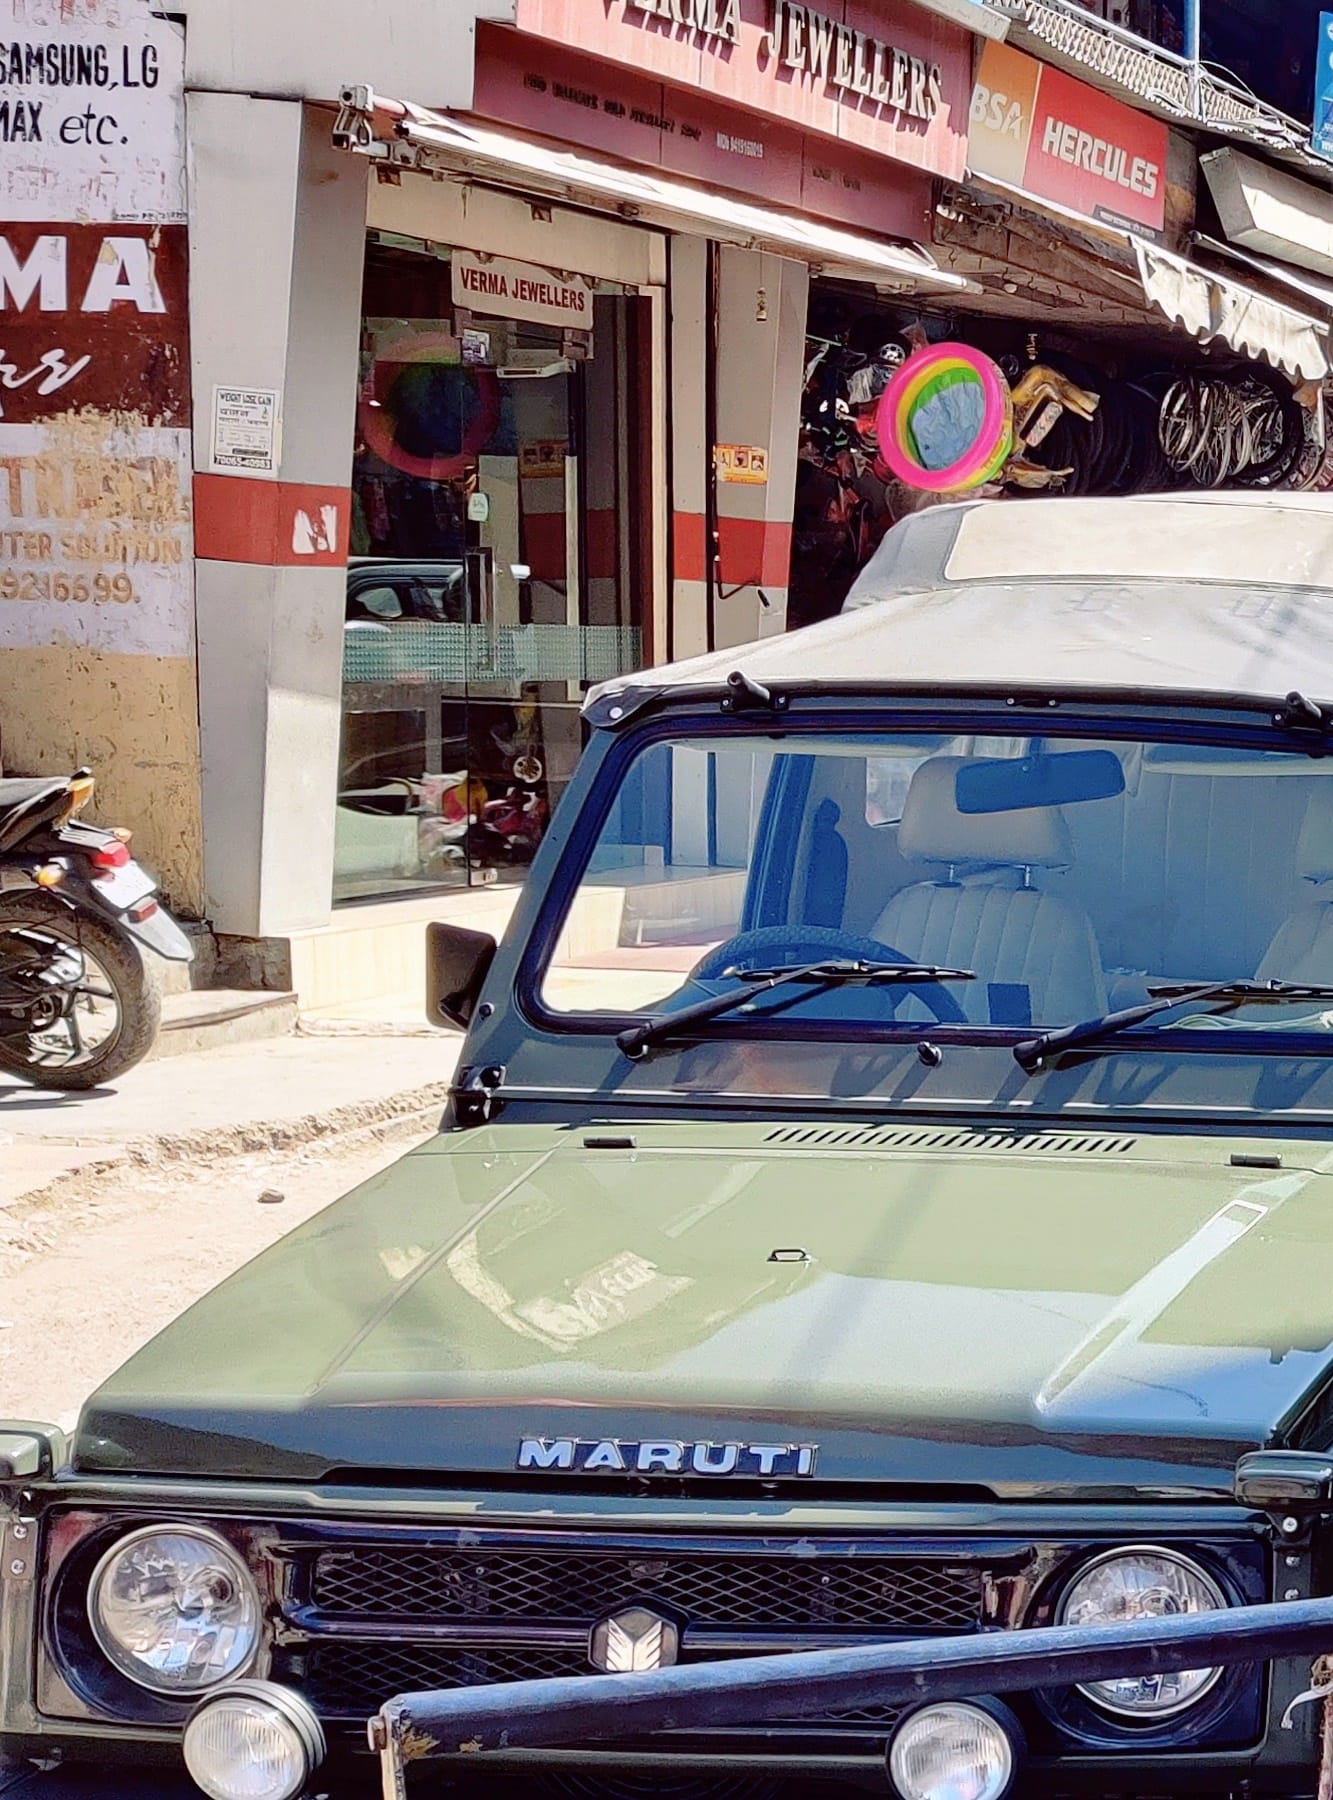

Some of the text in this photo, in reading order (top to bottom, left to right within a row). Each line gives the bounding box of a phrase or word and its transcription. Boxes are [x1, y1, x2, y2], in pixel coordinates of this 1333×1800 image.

[0, 42, 159, 91] SAMSUNG, LG
[760, 0, 943, 122] JEWELLERS
[59, 103, 129, 145] etc.
[970, 83, 1024, 140] BSA
[1041, 116, 1159, 199] HERCULES
[460, 266, 585, 312] VERMA JEWELLERS
[516, 1437, 820, 1476] MARUTI
